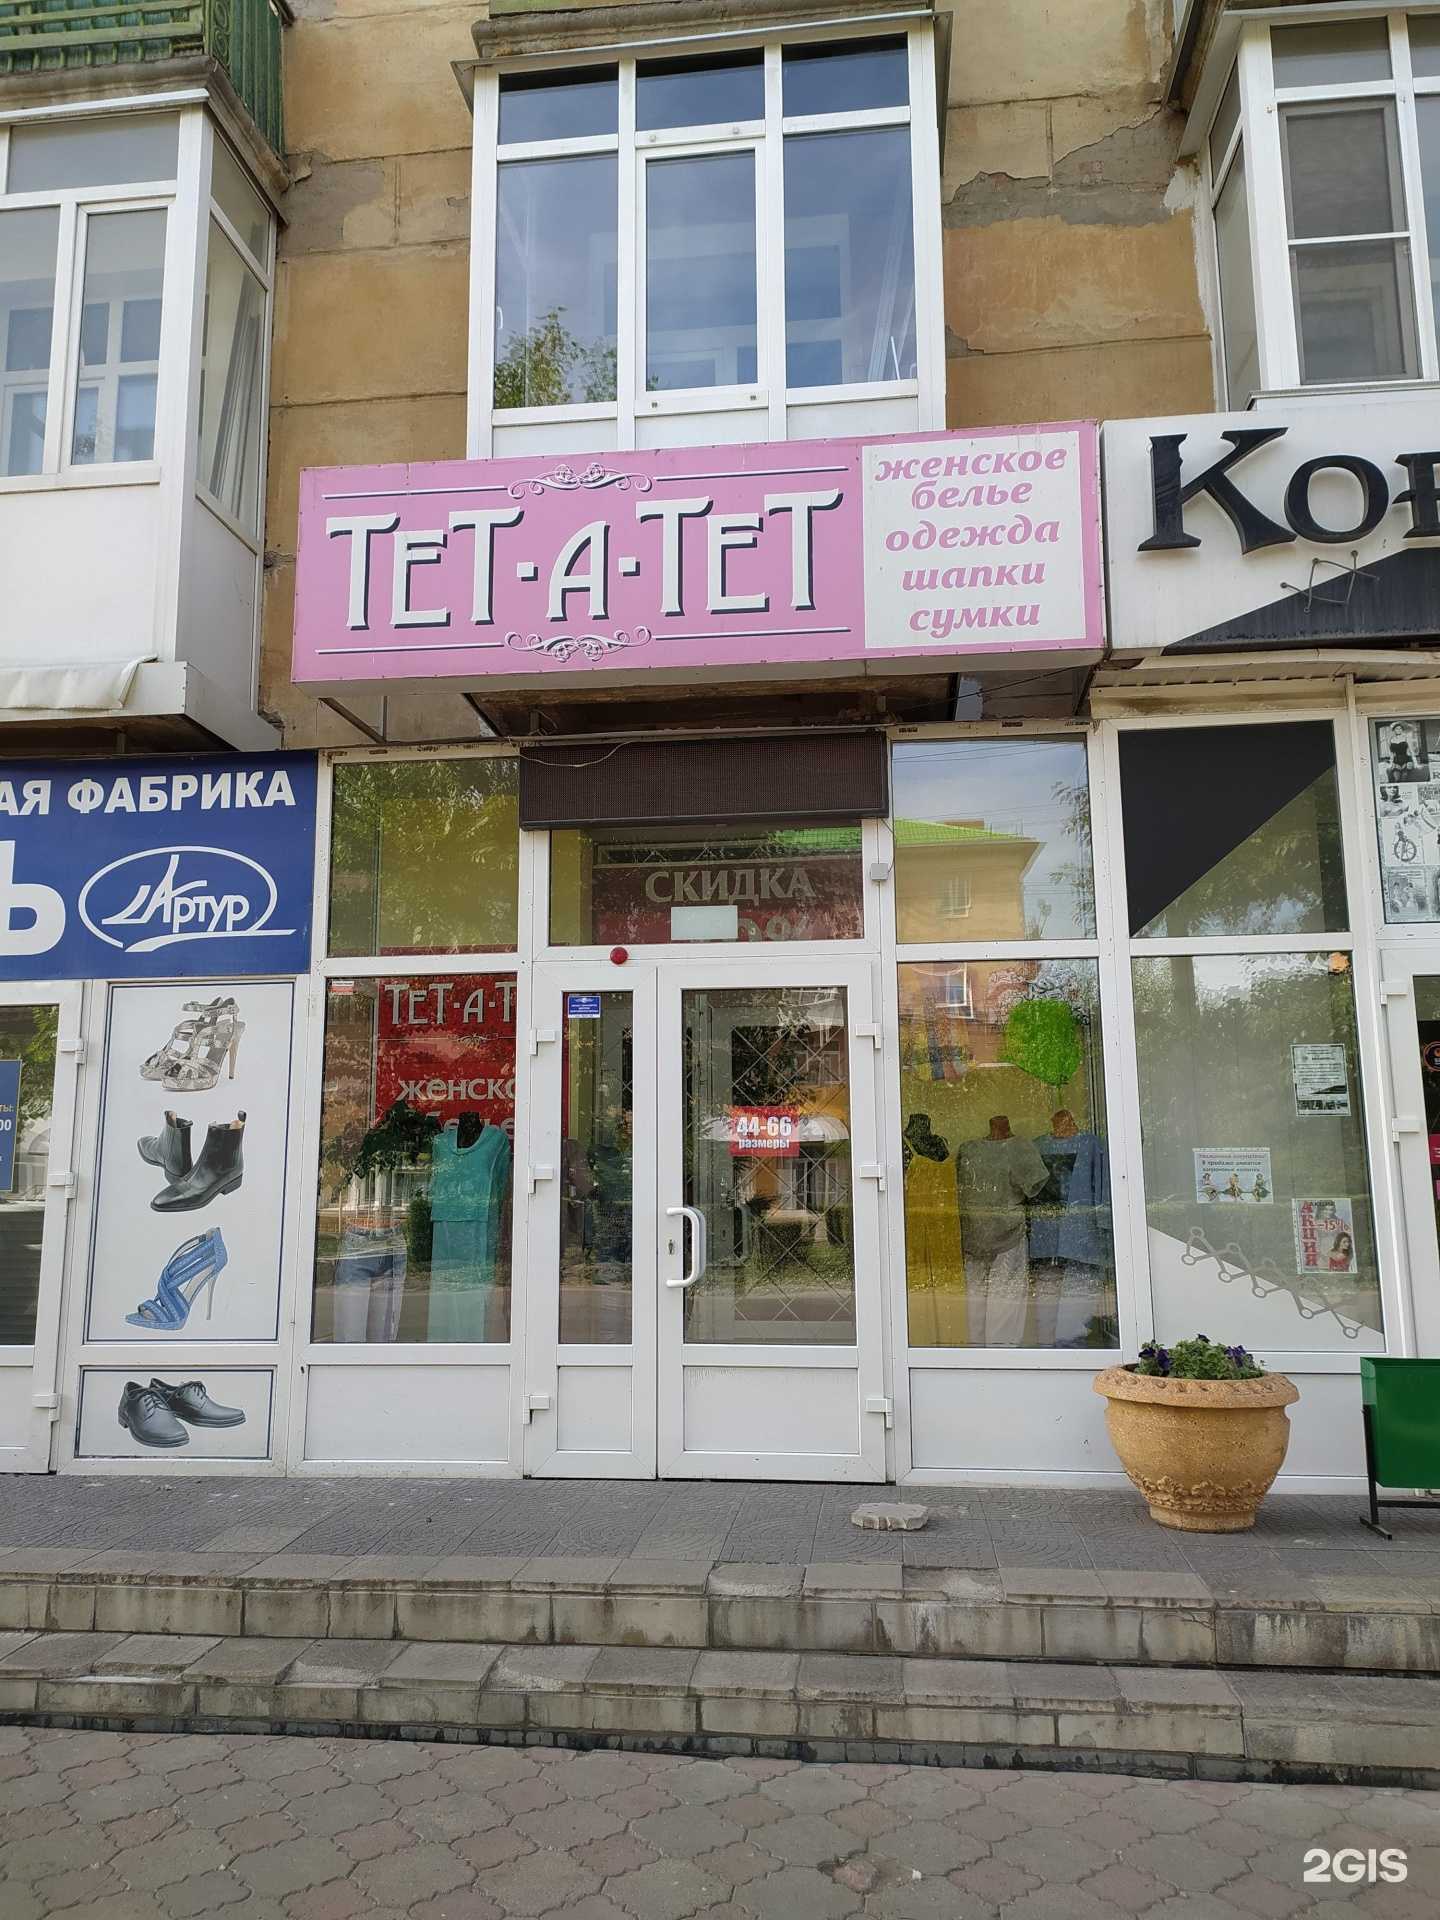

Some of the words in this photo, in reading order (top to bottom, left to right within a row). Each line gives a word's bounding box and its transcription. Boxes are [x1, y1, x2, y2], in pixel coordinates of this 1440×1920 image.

[873, 446, 1068, 481] женское
[911, 480, 1034, 511] белье
[885, 514, 1061, 552] одежда
[902, 561, 1046, 591] шапки
[909, 602, 1041, 639] сумки
[67, 770, 297, 814] ФАБРИКА
[101, 854, 250, 934] Артур
[645, 866, 817, 906] СКИДКА
[736, 1116, 792, 1137] 44-66
[738, 1138, 791, 1150] размеры
